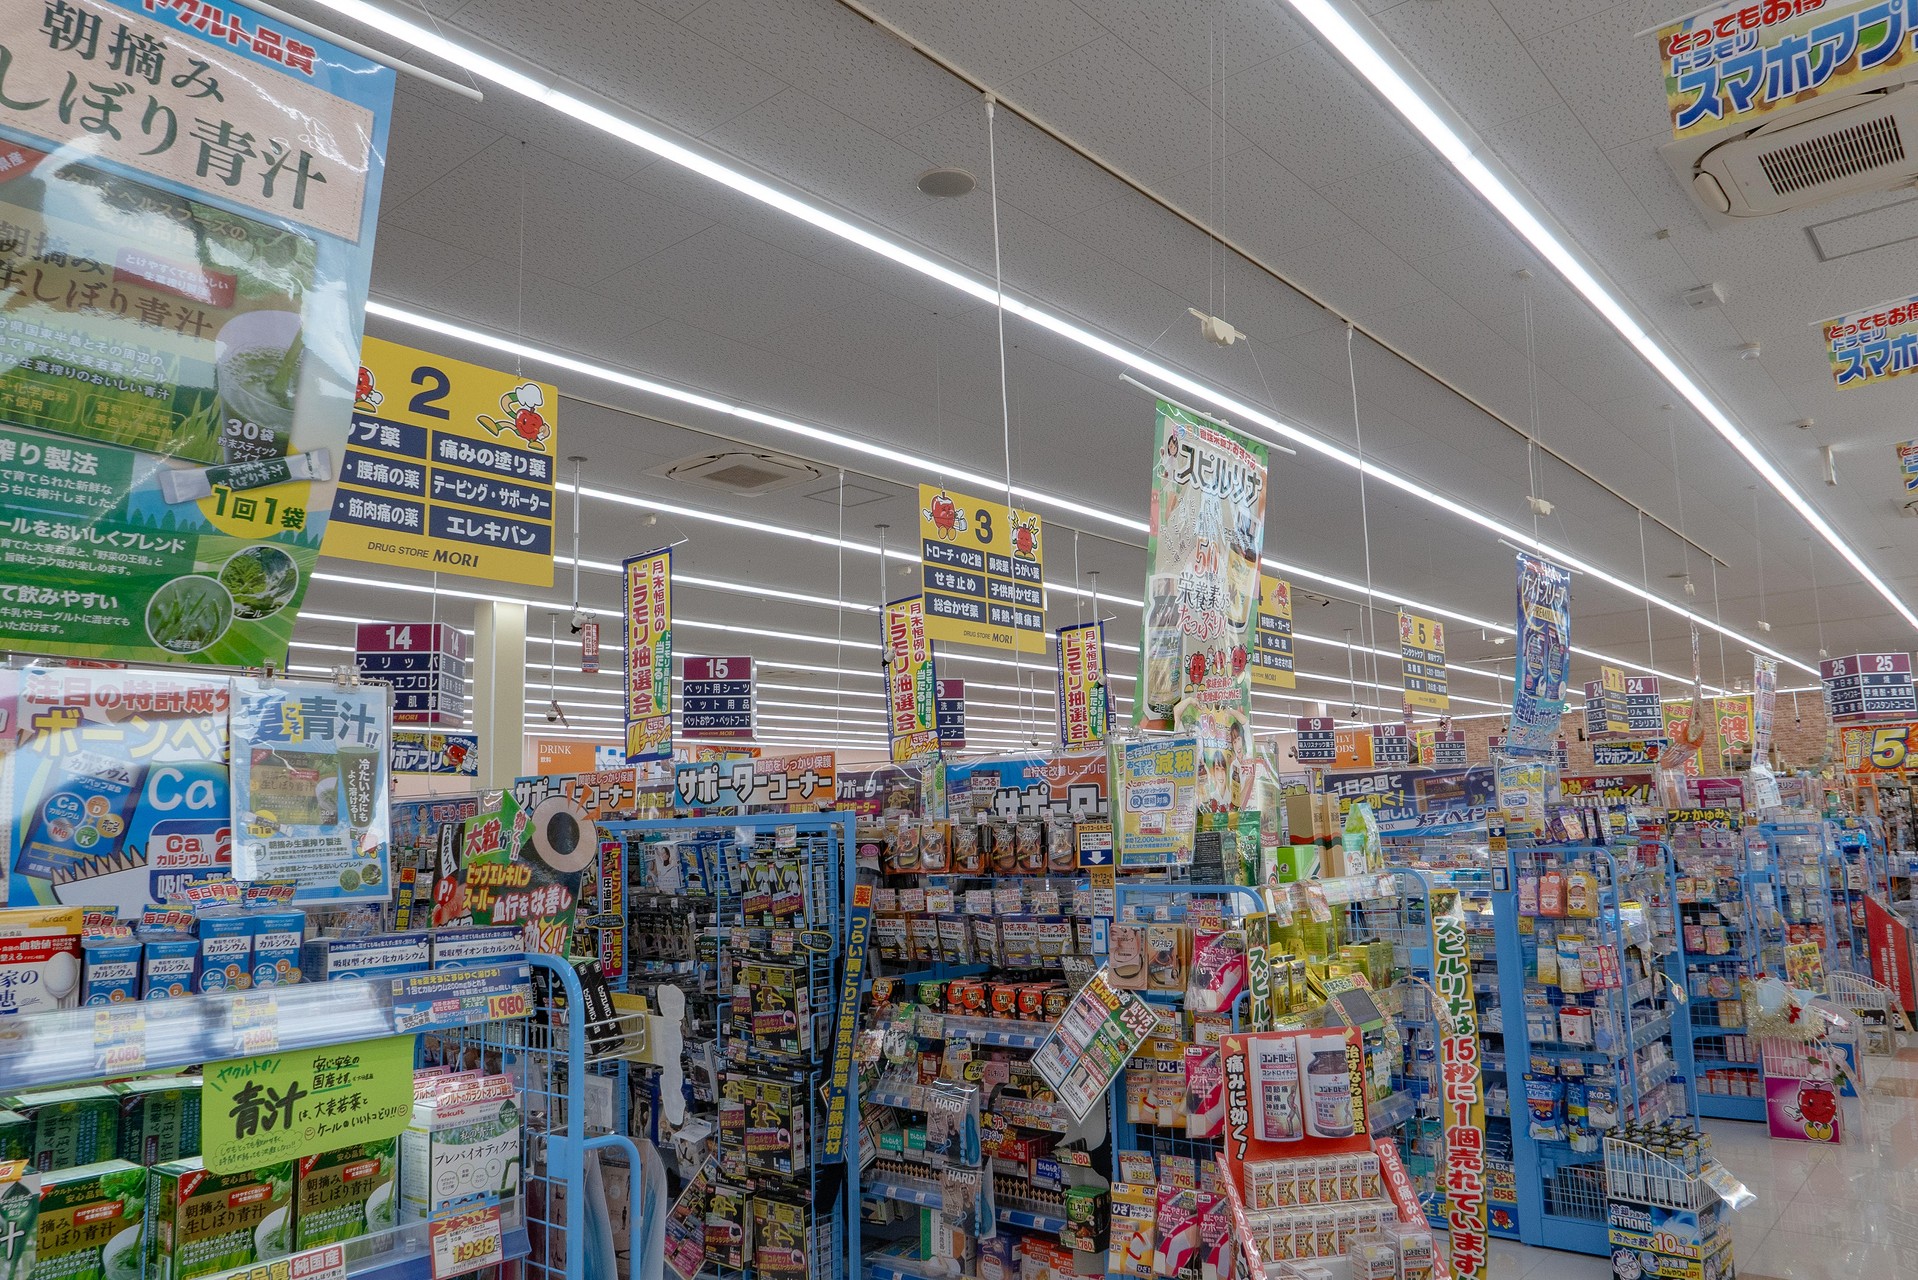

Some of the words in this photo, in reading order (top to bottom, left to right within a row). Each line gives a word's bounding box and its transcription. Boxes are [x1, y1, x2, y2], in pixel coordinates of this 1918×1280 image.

[39, 0, 225, 102] 朝摘み
[1671, 28, 1759, 77] ドラモリ
[1832, 326, 1887, 351] ドラモリ
[408, 366, 451, 420] 2
[227, 419, 275, 443] 30袋
[217, 436, 277, 458] 粉末スティック
[439, 438, 547, 479] 痛みの塗り薬
[1, 470, 113, 495] で育てられた新鮮な
[1175, 443, 1263, 508] スピルリナ
[433, 474, 550, 512] テーピング・サポーター
[213, 487, 306, 530] 1回1袋
[446, 516, 537, 546] エレキバン
[974, 508, 993, 544] 3
[367, 541, 396, 555] DRUG
[398, 544, 430, 559] STORE
[432, 549, 480, 569] MORI
[926, 544, 982, 568] トローチ・のど飴
[934, 571, 977, 592] せき止め
[2, 586, 118, 609] て飲みやすい
[652, 559, 666, 632] 月末恒例の
[990, 582, 1040, 605] 子供用かぜ薬
[1, 606, 131, 627] 牛乳やヨーグルトに混ぜても
[933, 597, 979, 618] 総合かぜ薬
[991, 607, 1041, 628] 解熱・鎮痛薬
[385, 626, 413, 650] 14
[632, 564, 652, 715] ドラモリ抽選会
[909, 602, 926, 662] 月末恒例の
[963, 629, 977, 637] DRUG
[977, 632, 991, 640] STORE
[992, 634, 1013, 645] MORI
[1418, 623, 1426, 644] 5
[450, 631, 460, 656] 14
[358, 656, 440, 669] スリッパ
[1084, 630, 1099, 682] 月末恒例の
[1875, 655, 1894, 672] 25
[705, 659, 729, 679] 15
[889, 607, 916, 732] ドラモリ抽選会
[1831, 659, 1846, 677] 25
[684, 683, 750, 695] ペット用シーツ
[1066, 632, 1089, 740] ドラモリ抽選会
[1627, 678, 1644, 694] 24
[684, 699, 750, 711] ペット用品
[1866, 701, 1914, 710] インスタントコーヒー
[684, 715, 750, 730] ペットおやつ・ペットフード
[1309, 718, 1322, 730] 19
[1384, 725, 1396, 736] 20
[540, 744, 571, 755] DRINK
[1595, 750, 1645, 765] スマホアプリ
[1845, 730, 1863, 770] 本日!!
[756, 754, 833, 774] 関節をしっかり保護
[1022, 763, 1106, 779] 血行を改善し、コリに
[1154, 750, 1195, 775] 減税
[148, 767, 217, 811] Ca
[578, 771, 634, 787] 関節をしっかり保護
[677, 764, 833, 804] サポーターコーナー
[1333, 774, 1402, 797] 1日2回で
[1595, 776, 1624, 787] 飲んで
[347, 770, 360, 823] よく溶ける!
[358, 757, 372, 823] 冷たい水にも
[48, 807, 81, 821] カルシウム
[57, 796, 80, 813] Ca
[1667, 808, 1726, 822] フケ・かゆみ
[52, 825, 68, 839] Mg
[80, 836, 91, 846] K
[166, 834, 203, 854] Ca
[268, 837, 342, 850] 朝摘み生葉搾り製法
[157, 851, 211, 867] カルシウム
[401, 868, 416, 884] 薬
[465, 863, 533, 887] ピップエレキバン
[461, 887, 495, 912] スーパー
[492, 883, 573, 924] 血行を改善し
[853, 885, 873, 907] 薬
[42, 914, 73, 924] Kracie
[1200, 916, 1218, 928] 798
[207, 943, 248, 953] カルシウム
[259, 938, 298, 949] カルシウム
[438, 944, 522, 958] 吸収型イオン化カルシウム
[152, 964, 191, 974] カルシウム
[332, 951, 426, 968] 吸収型イオン化カルシウム
[93, 970, 133, 978] カルシウム
[206, 972, 221, 981] Ca
[257, 966, 272, 976] Ca
[489, 994, 525, 1020] 1,980
[1119, 1008, 1148, 1039] レシピ
[825, 916, 869, 1157] つらい肩こりに磁気治療器・温熱商材
[107, 1047, 140, 1063] 2,080
[1126, 1059, 1144, 1070] 手首
[216, 1060, 272, 1084] ヤクルトの
[1158, 1060, 1176, 1074] ひじ
[1264, 1085, 1289, 1094] 関節痛
[1588, 1090, 1612, 1099] 氷のう
[229, 1080, 308, 1140] 青汁
[436, 1108, 466, 1120] Yakult
[935, 1098, 963, 1113] HARD
[1226, 1054, 1250, 1161] 痛みに効く!
[1266, 1103, 1287, 1111] 神経痛
[460, 1125, 495, 1141] 私の青汁
[434, 1139, 518, 1168] プレバイオティクス
[1072, 1153, 1088, 1165] 980
[306, 1174, 342, 1193] 朝摘み
[948, 1170, 976, 1184] HARD
[1174, 1171, 1191, 1187] 798
[305, 1178, 376, 1208] 生しぼり青汁
[1493, 1188, 1515, 1200] 858
[185, 1199, 226, 1218] 朝摘み
[1112, 1203, 1130, 1216] ひざ
[184, 1204, 267, 1236] 生しぼり青汁
[1158, 1212, 1193, 1226] サポーター
[1609, 1215, 1653, 1233] STRONG
[451, 1235, 496, 1264] 1,938
[293, 1249, 341, 1276] 純国産
